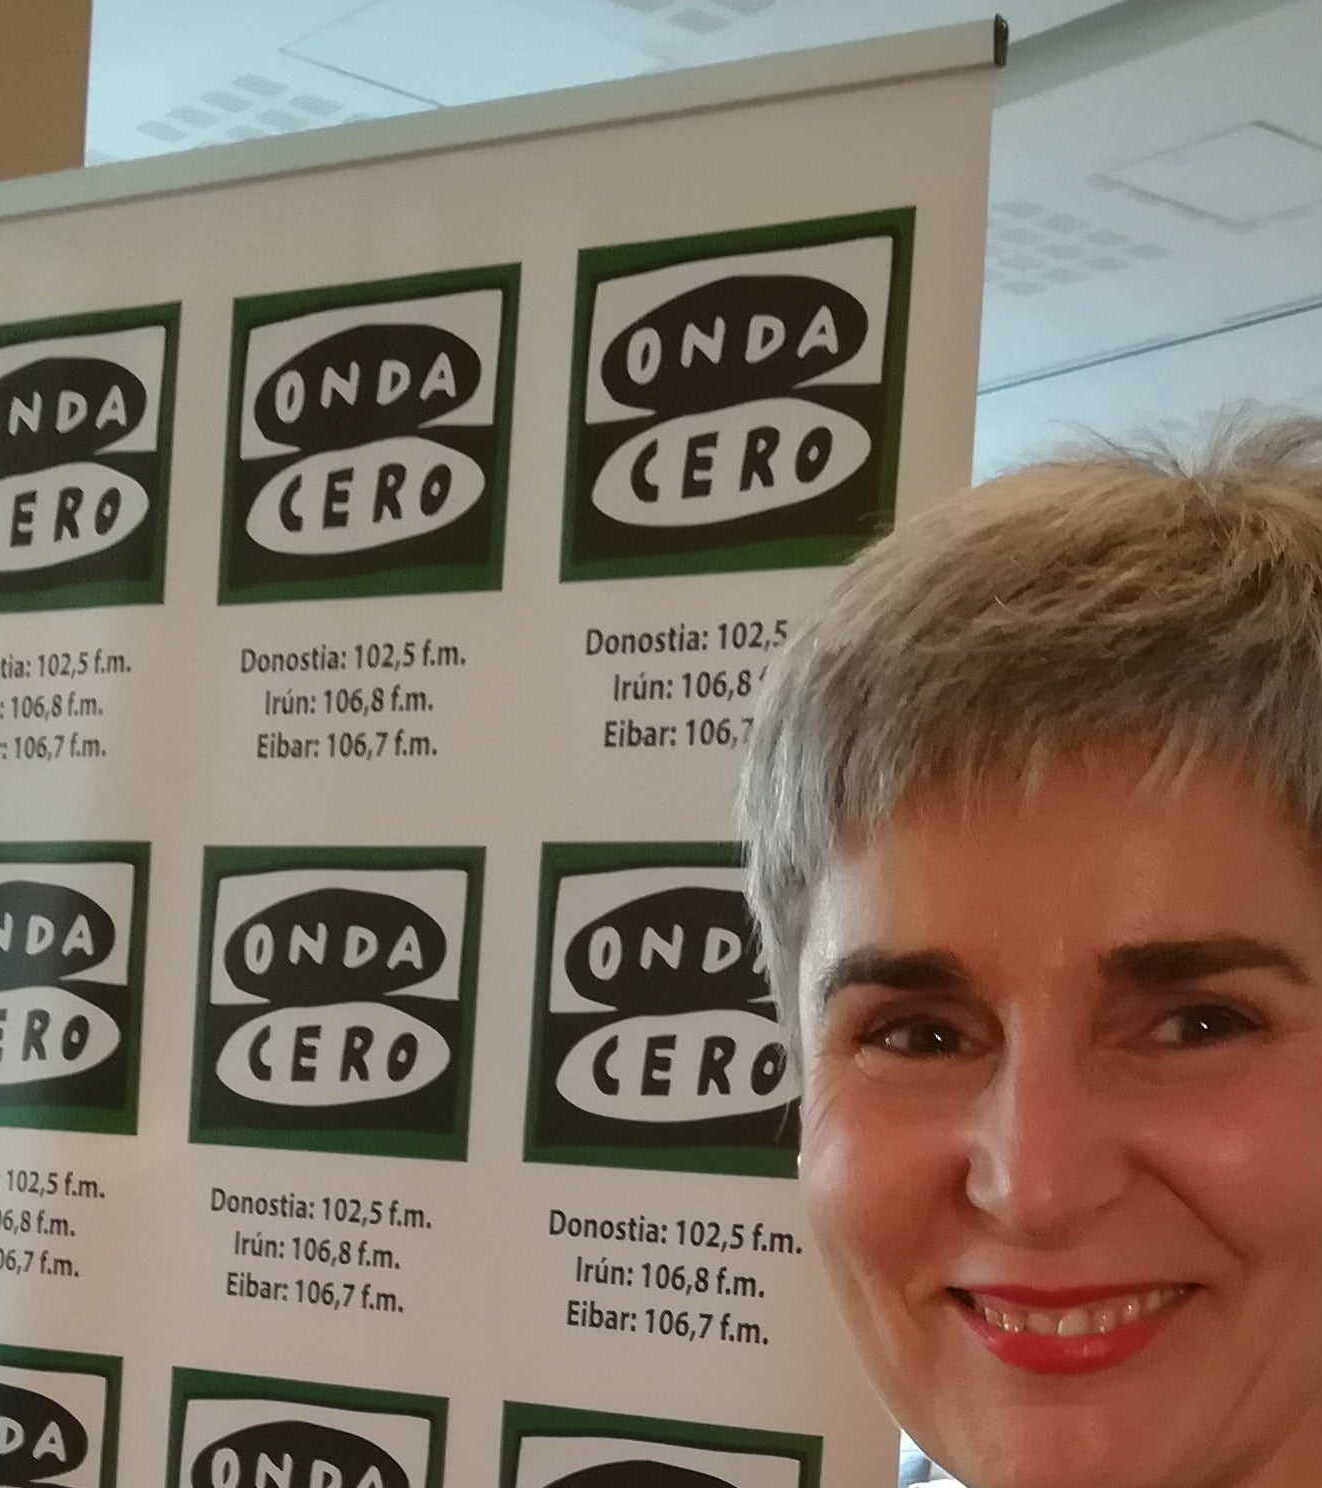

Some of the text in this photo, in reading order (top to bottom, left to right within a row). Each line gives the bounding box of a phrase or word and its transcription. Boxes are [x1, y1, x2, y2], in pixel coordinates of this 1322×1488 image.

[627, 306, 838, 384] ONDA
[276, 353, 456, 423] ONDA
[631, 426, 832, 502] CERO
[280, 464, 451, 532] CERO
[240, 638, 466, 674] Donostia: 102,5 f.m.
[585, 619, 788, 656] Donostia: 102,5
[37, 651, 89, 680] 102,5
[93, 647, 132, 675] f.m.
[264, 684, 434, 717] Irún: 106,8 f.m.
[613, 669, 752, 702] Irún: 106,8
[11, 693, 63, 722] 106,8
[67, 690, 104, 717] f.m.
[14, 734, 66, 761] 106,7
[69, 731, 107, 758] f.m.
[256, 728, 438, 761] Eibar: 106,7 f.m.
[603, 717, 755, 749] Eibar: 106,7
[245, 923, 422, 974] ONDA
[249, 1025, 418, 1082] CERO
[593, 1035, 787, 1096] CERO
[6, 1169, 59, 1197] 102,5
[63, 1171, 106, 1199] f.m.
[36, 1209, 76, 1237] f.m.
[210, 1187, 432, 1230] Donostia: 102,5 f.m.
[234, 1230, 401, 1270] Irún: 106,8 f.m.
[548, 1209, 803, 1255] Donostia: 102,5 f.m.
[39, 1249, 80, 1278] f.m.
[576, 1255, 765, 1299] Irún: 106,8 f.m.
[226, 1271, 404, 1313] Eibar: 106,7 f.m.
[566, 1299, 769, 1346] Eibar: 106,7 f.m.
